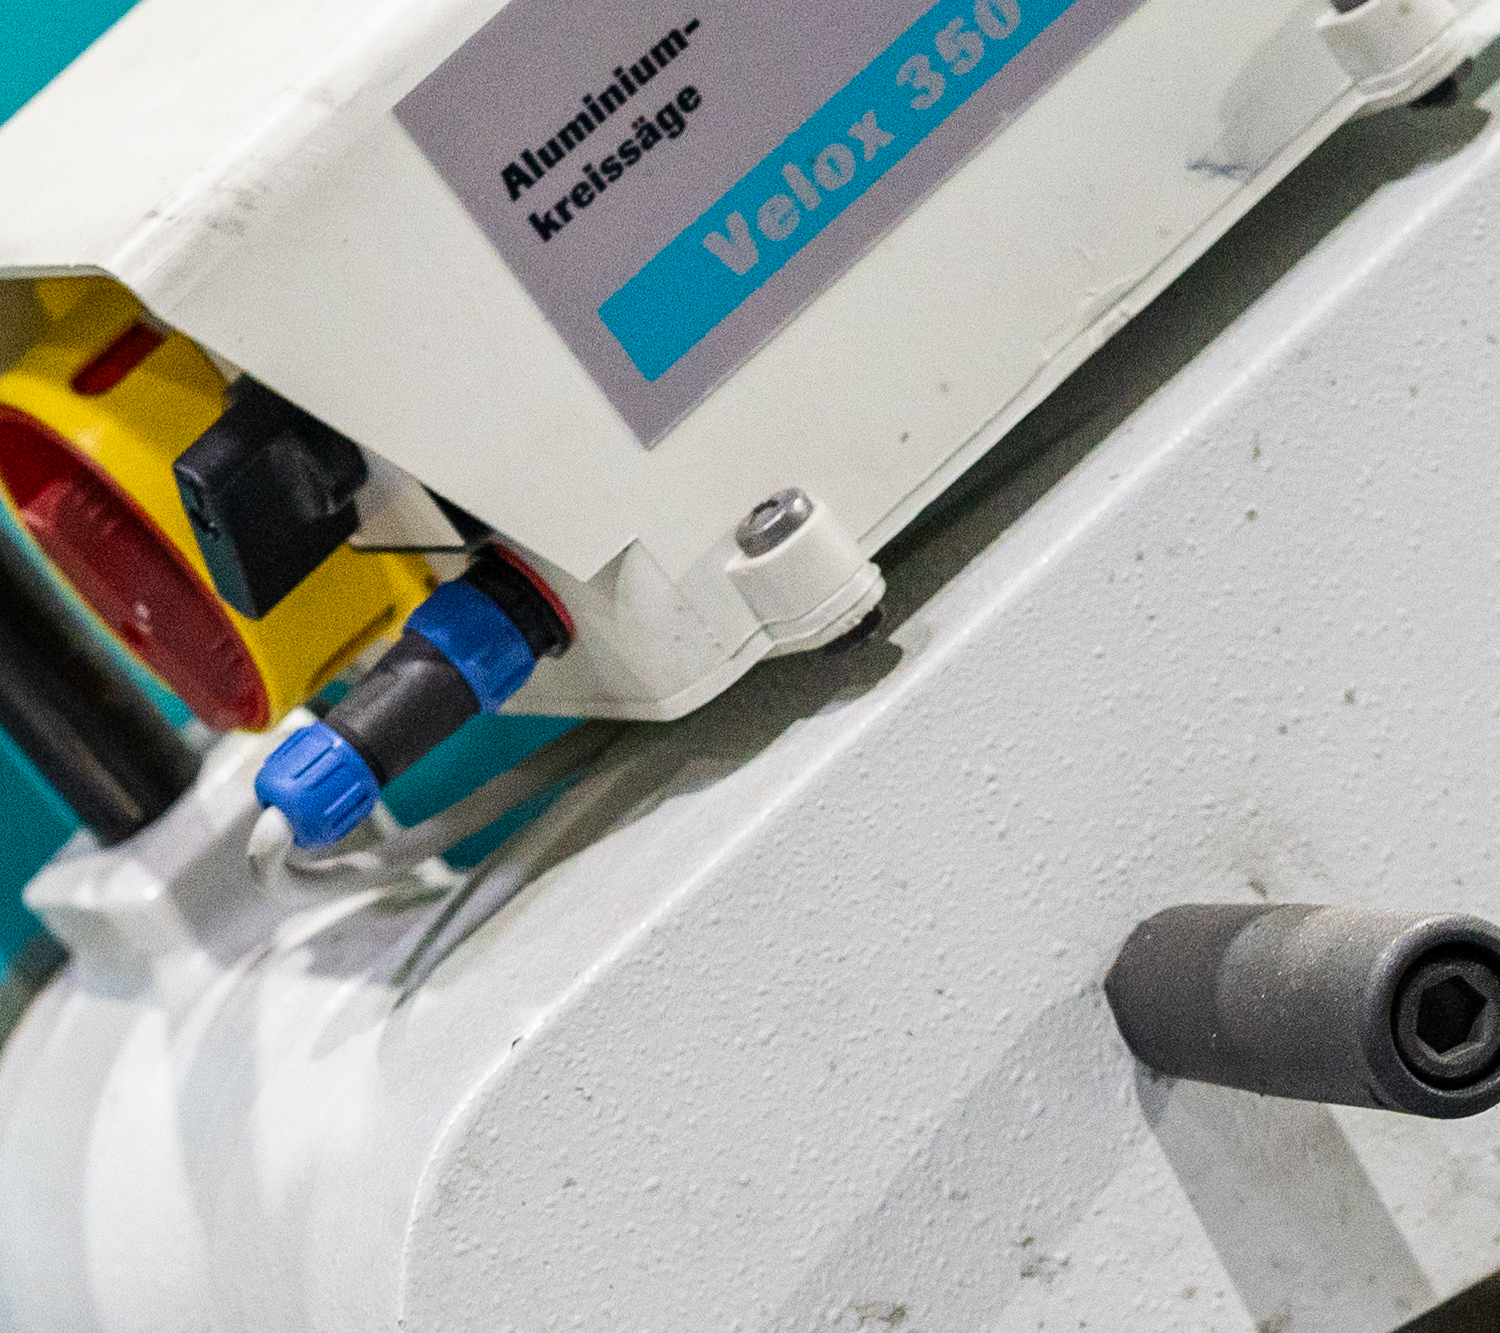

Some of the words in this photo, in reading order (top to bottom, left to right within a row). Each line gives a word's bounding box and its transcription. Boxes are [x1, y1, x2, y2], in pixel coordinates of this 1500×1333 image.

[501, 18, 700, 201] Aluminium-
[528, 85, 701, 242] kreissäge
[702, 110, 895, 275] Velox
[896, 0, 1021, 110] 350
